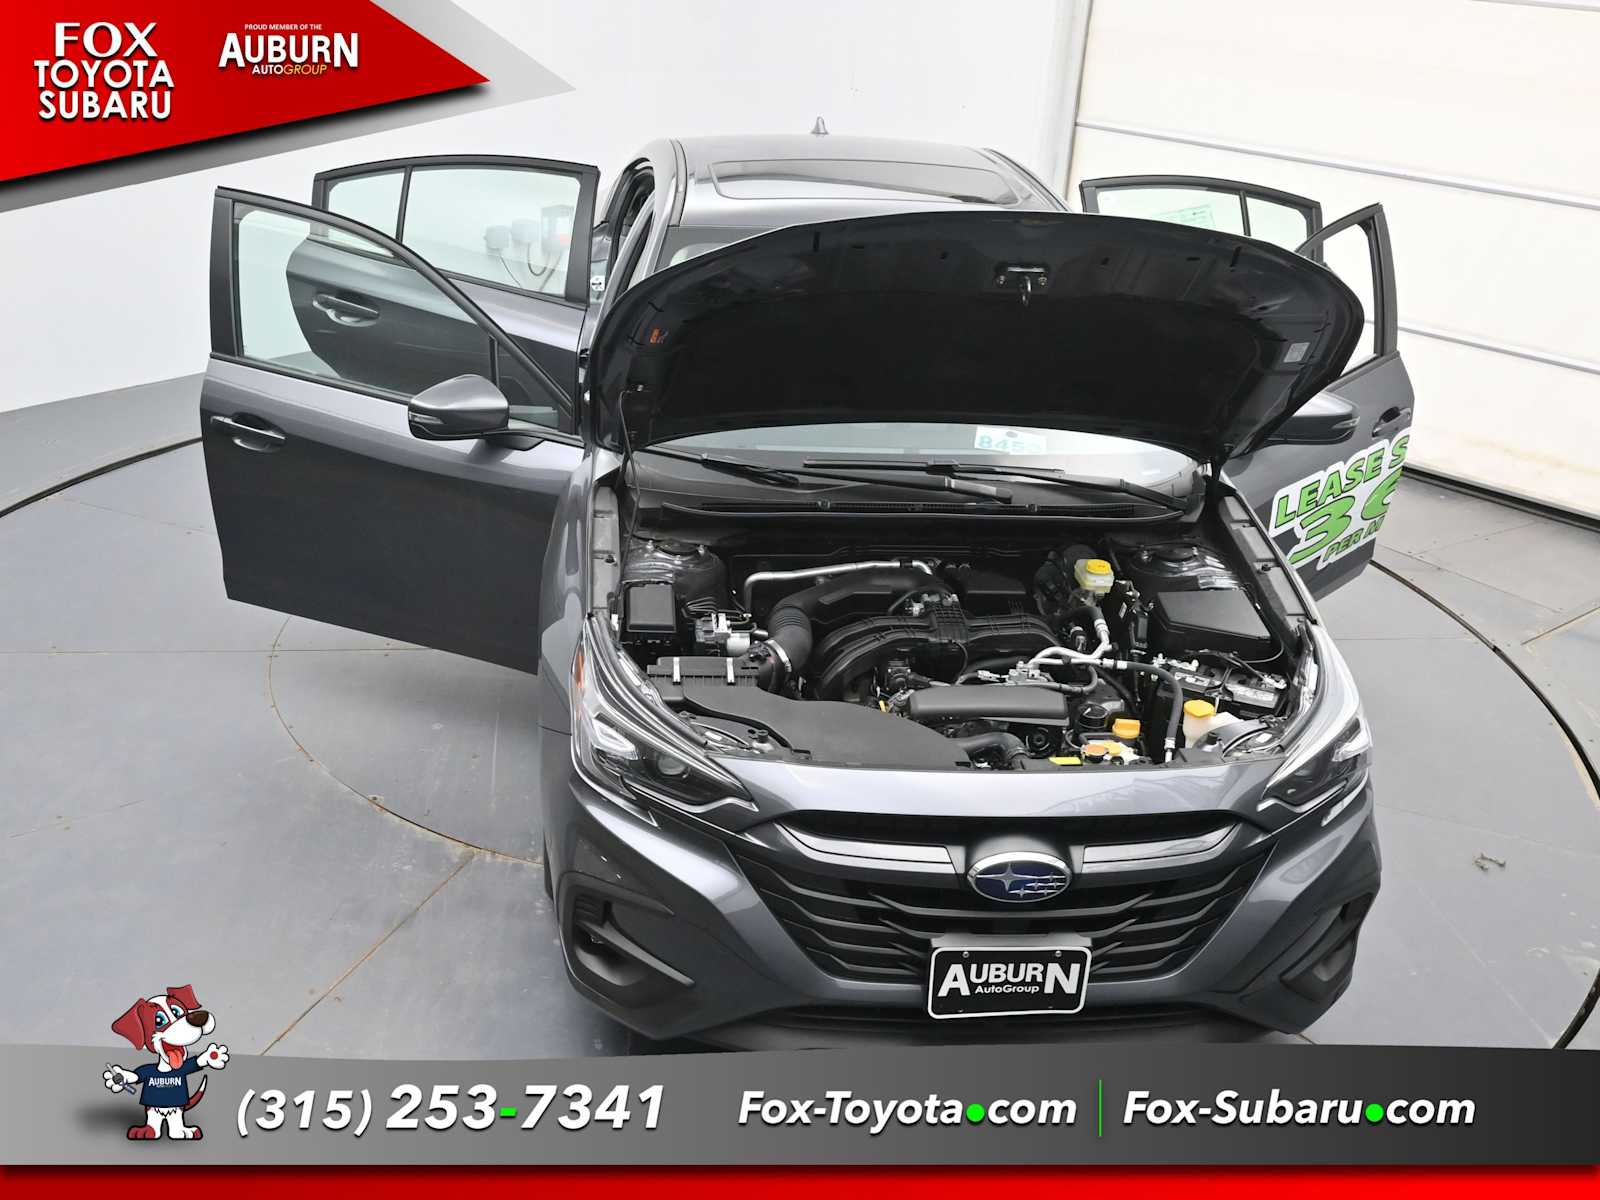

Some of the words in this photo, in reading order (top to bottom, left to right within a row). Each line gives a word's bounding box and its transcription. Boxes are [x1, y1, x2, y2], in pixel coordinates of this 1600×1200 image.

[978, 434, 1041, 454] 845
[1274, 447, 1386, 529] LEASE
[1322, 527, 1364, 563] PER
[937, 962, 1081, 998] AUBURN
[974, 984, 1040, 995] AutoGroup
